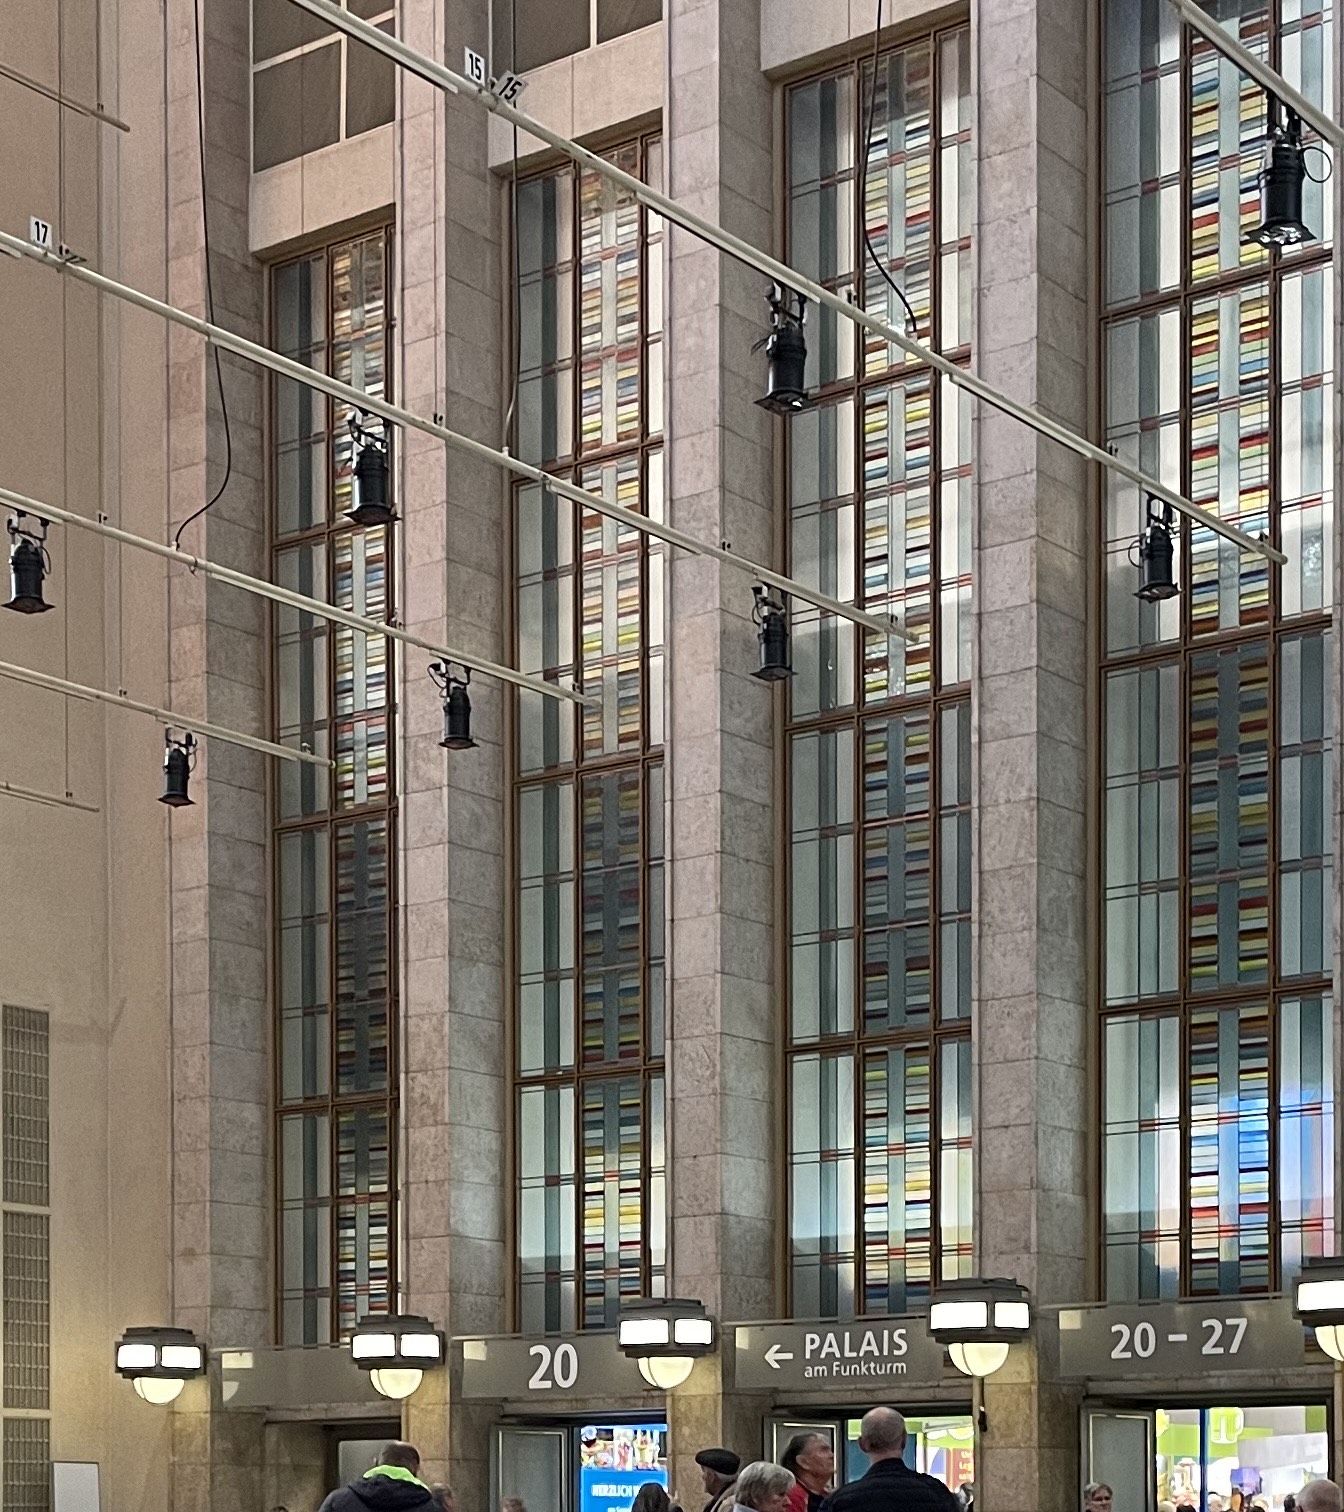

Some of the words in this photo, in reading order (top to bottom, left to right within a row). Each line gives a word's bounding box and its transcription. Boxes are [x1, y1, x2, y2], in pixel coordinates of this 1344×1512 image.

[469, 53, 482, 81] 15
[498, 76, 523, 100] 15
[34, 220, 48, 244] 17
[805, 1328, 908, 1359] PALAIS
[1111, 1322, 1156, 1359] 20
[1201, 1317, 1248, 1355] 27
[528, 1343, 578, 1389] 20
[804, 1365, 828, 1378] am
[832, 1360, 907, 1376] Funkturm
